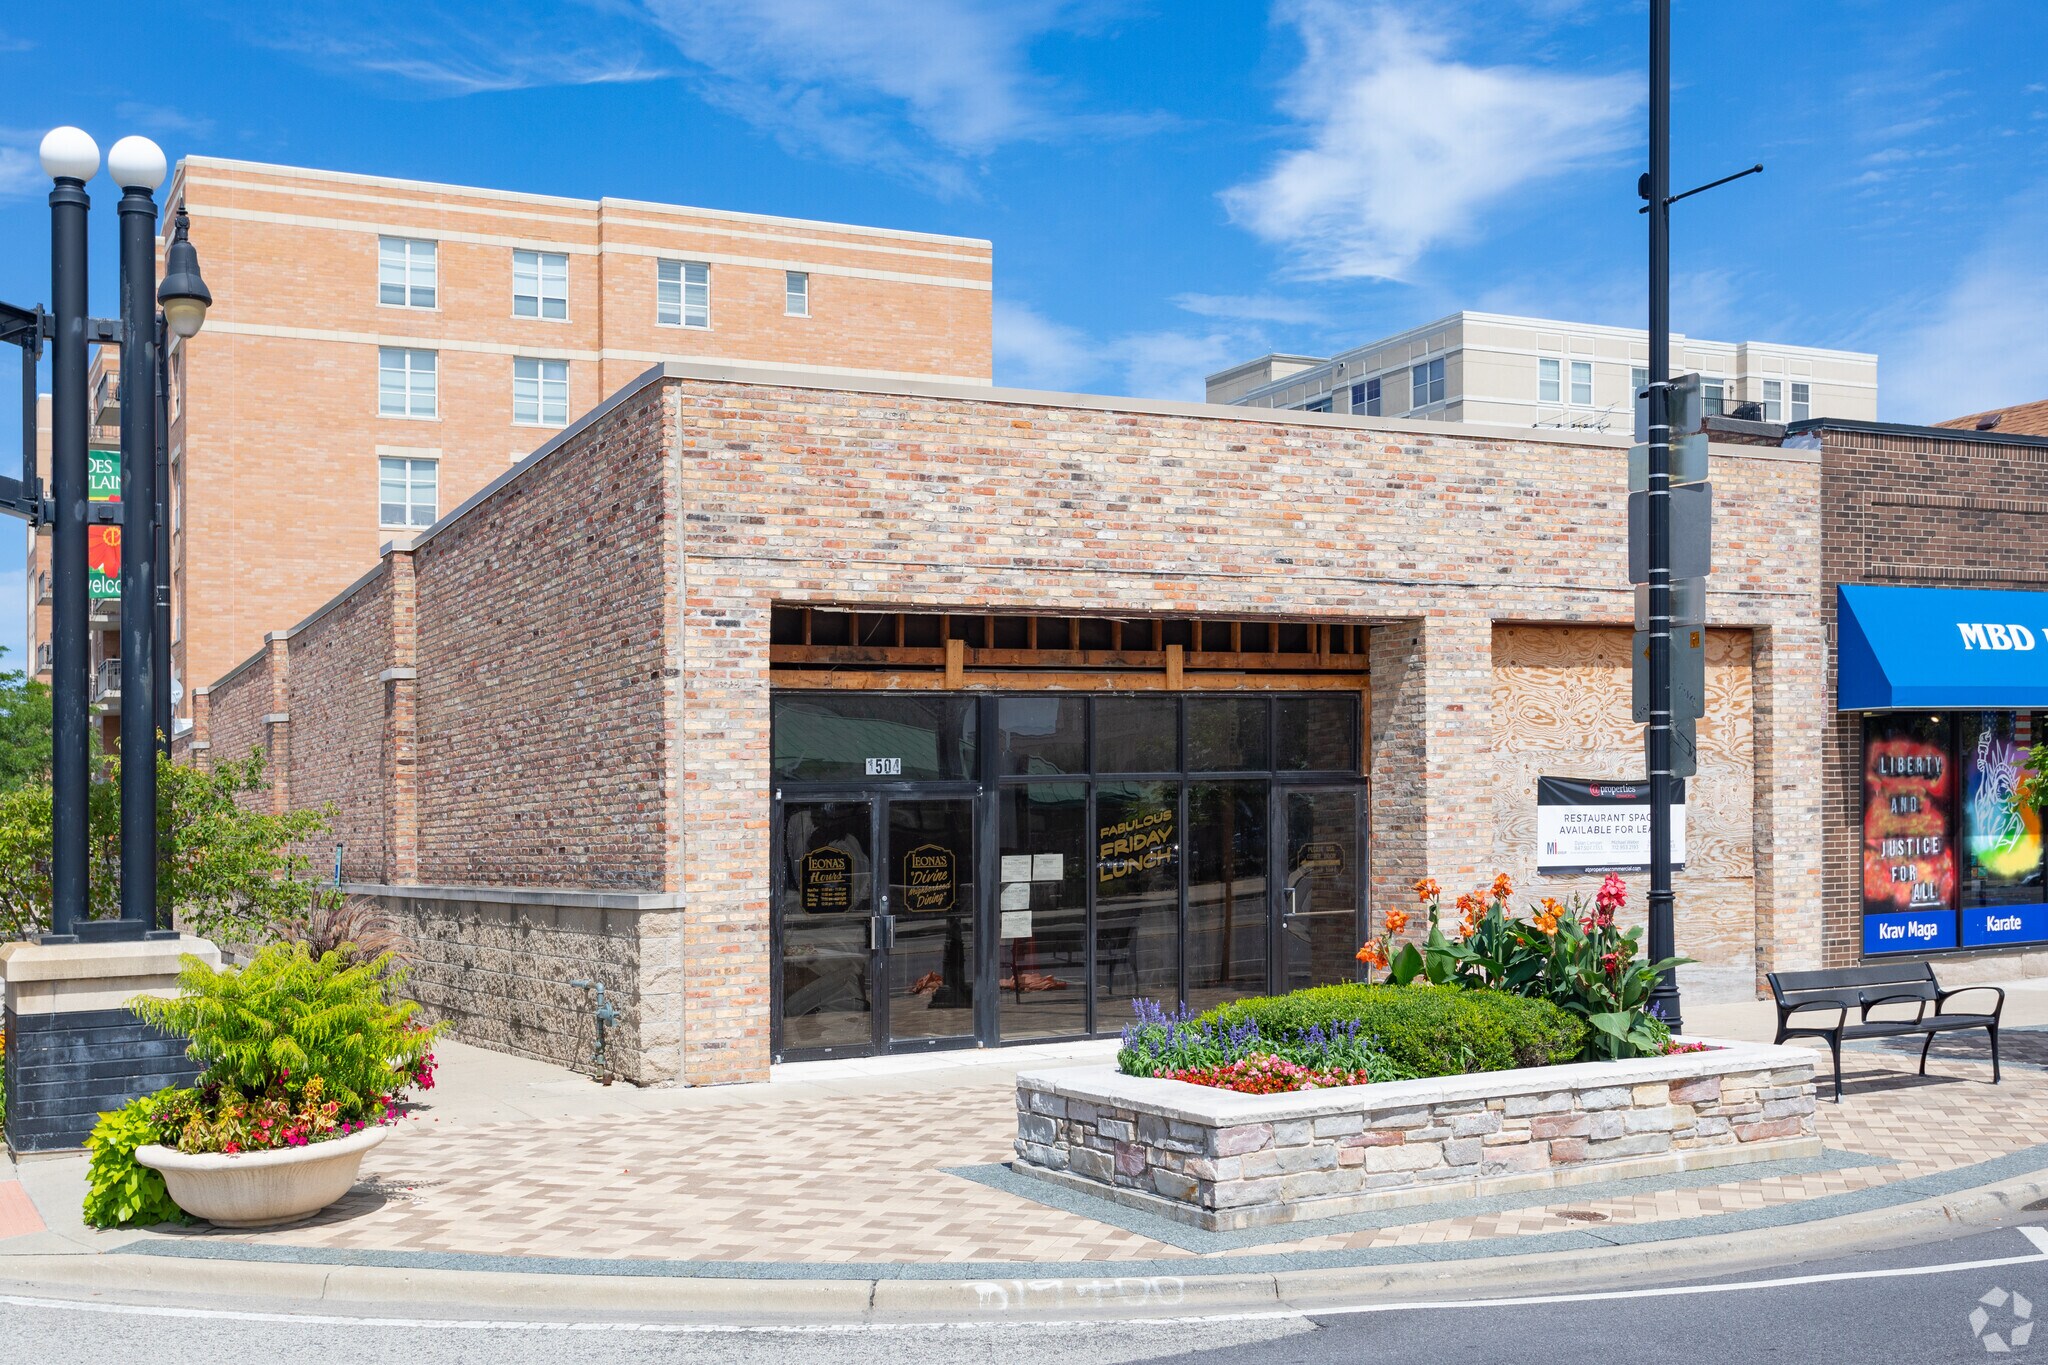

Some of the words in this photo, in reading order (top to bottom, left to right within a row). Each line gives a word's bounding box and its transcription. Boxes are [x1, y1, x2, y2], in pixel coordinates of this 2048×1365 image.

[89, 457, 112, 473] DES
[89, 475, 121, 489] LAIN
[89, 575, 121, 593] elco
[1956, 623, 2035, 650] MBD
[1879, 756, 1942, 775] LIBERTY
[1891, 796, 1917, 814] AND
[1100, 809, 1172, 839] FABULOUS
[1564, 813, 1626, 822] RESTAURANT
[1629, 813, 1651, 822] SPAC
[1560, 826, 1612, 834] AVAILABLE
[1615, 825, 1634, 834] FOR
[1100, 825, 1173, 860] FRIDAY
[1881, 837, 1939, 857] JUSTICE
[1100, 847, 1172, 882] LUNCH
[810, 871, 843, 883] Hours
[1891, 867, 1917, 883] FOR
[1914, 884, 1937, 900] ALL
[1879, 922, 1905, 939] Krav
[1908, 921, 1938, 941] Maga
[1986, 915, 2022, 932] Karate
